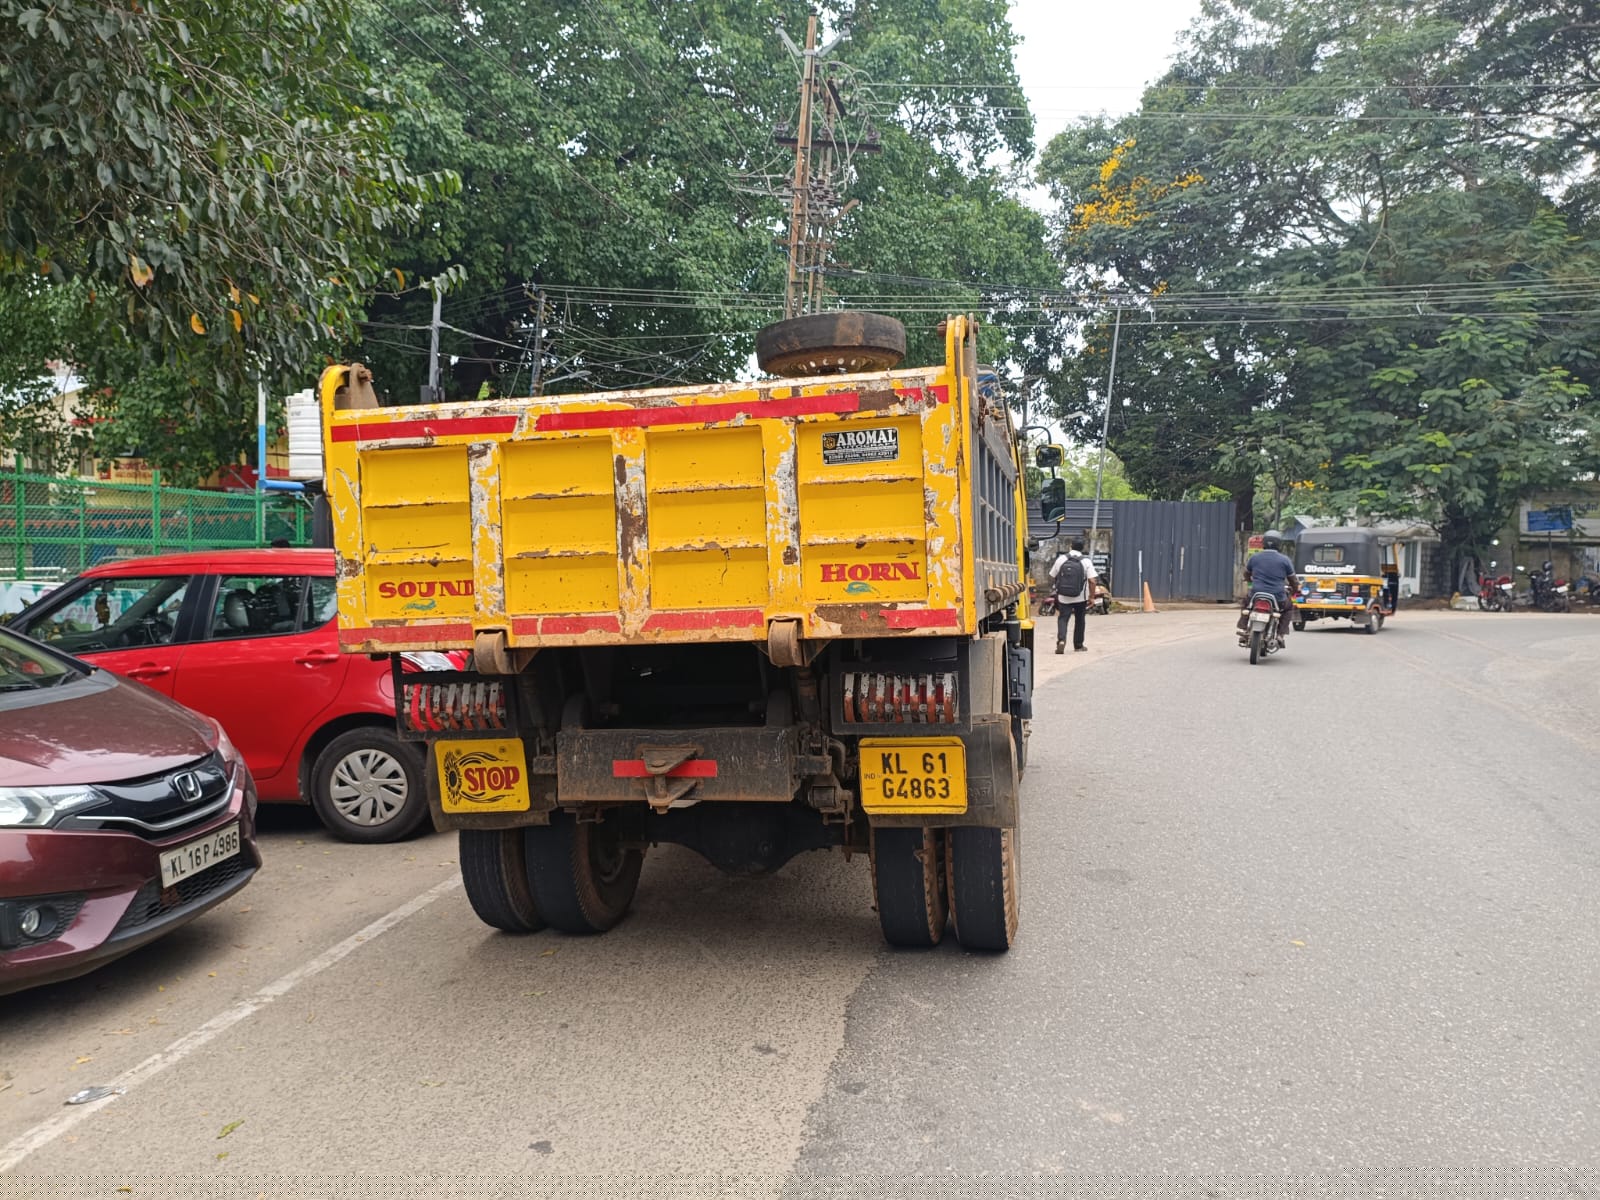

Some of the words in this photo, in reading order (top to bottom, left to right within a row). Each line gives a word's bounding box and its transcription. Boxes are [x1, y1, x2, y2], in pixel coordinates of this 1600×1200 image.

[837, 430, 897, 446] AROMAL
[820, 562, 921, 582] HORN
[881, 752, 908, 775] KL
[922, 752, 947, 774] 61
[464, 766, 520, 793] STOP
[864, 772, 876, 780] IND
[882, 777, 950, 799] G4863
[171, 856, 186, 878] KL
[188, 847, 202, 870] 16
[203, 843, 210, 863] P
[213, 832, 237, 857] 4986
